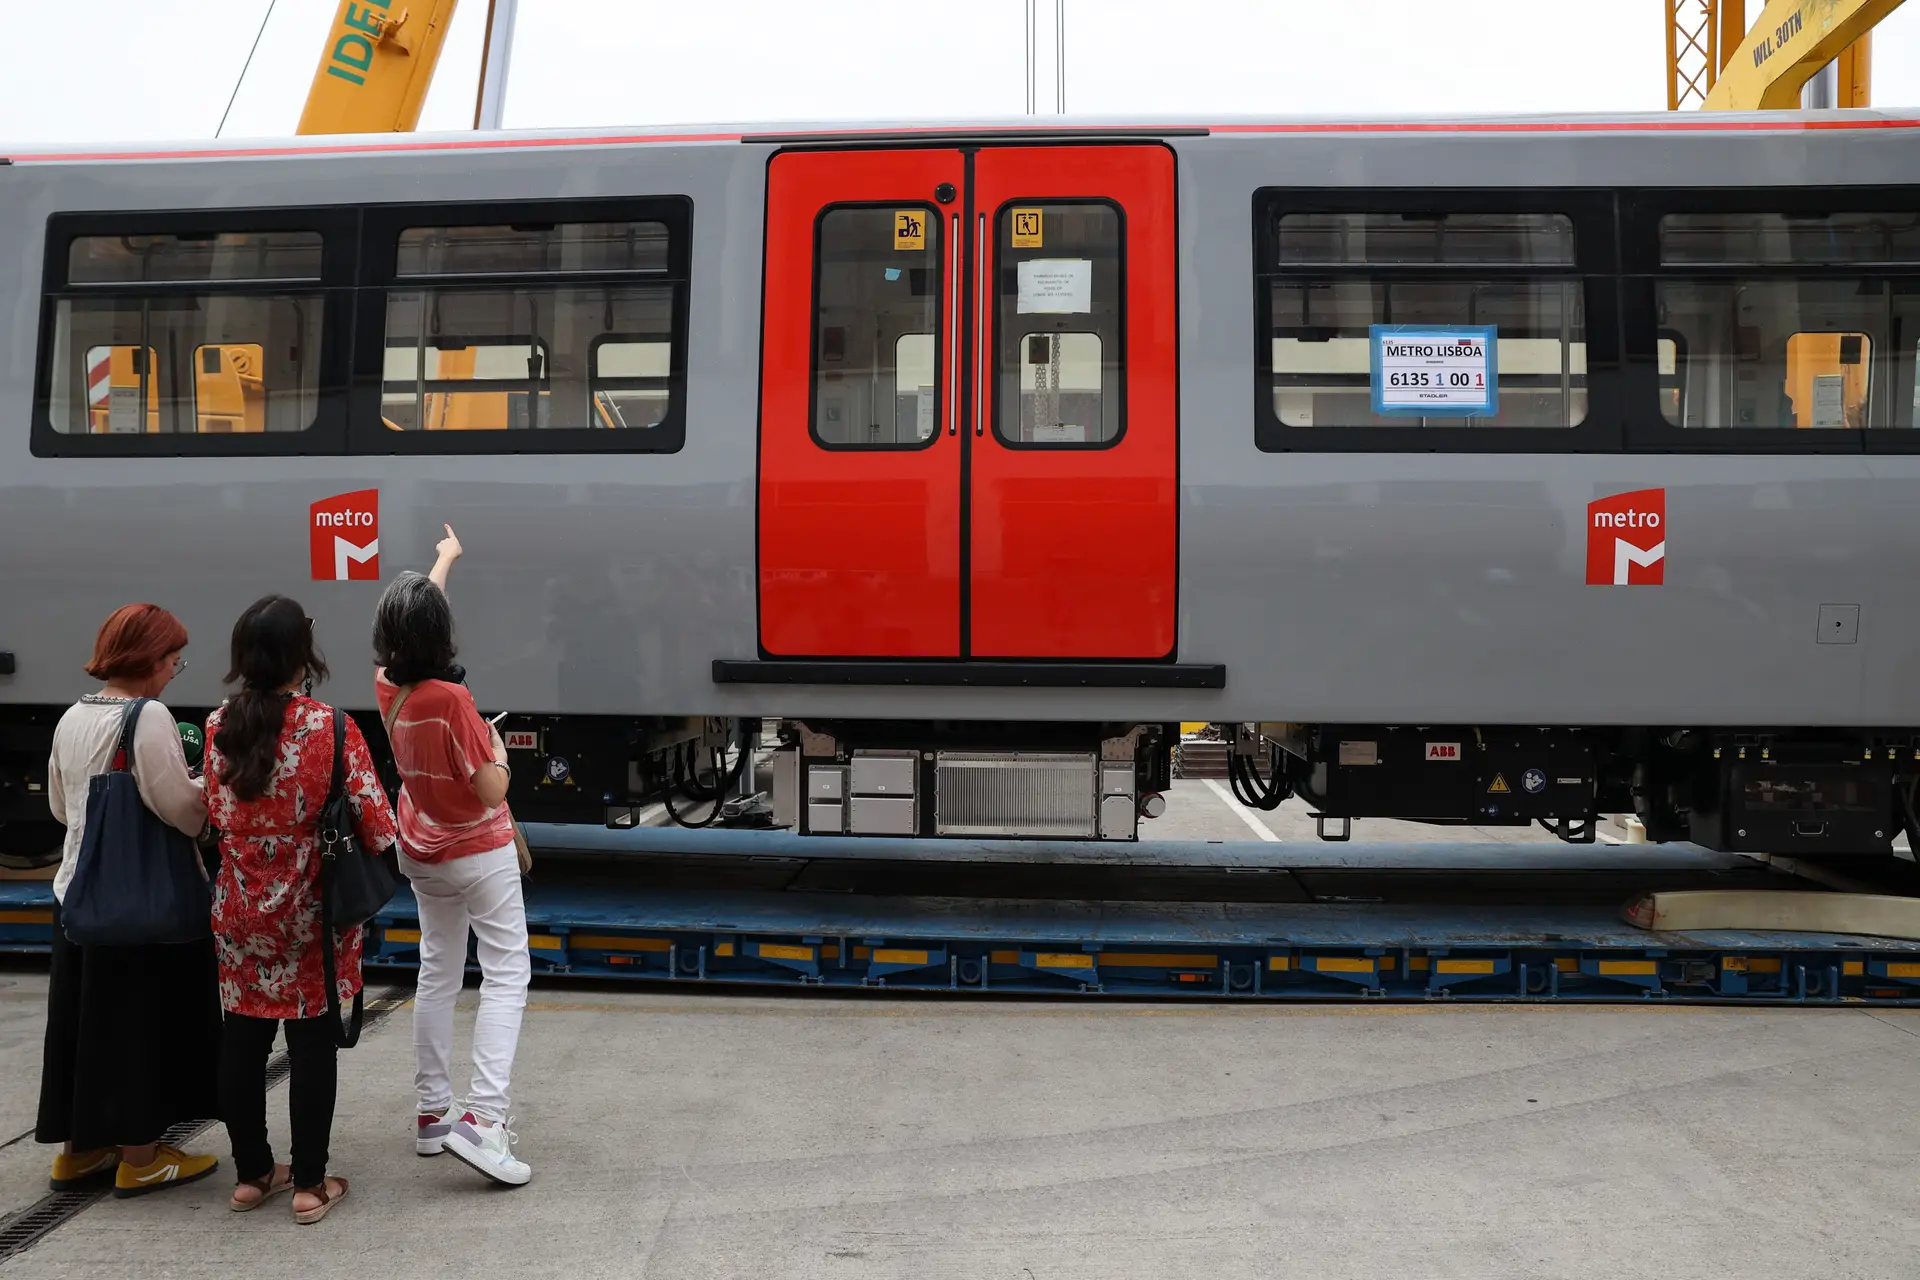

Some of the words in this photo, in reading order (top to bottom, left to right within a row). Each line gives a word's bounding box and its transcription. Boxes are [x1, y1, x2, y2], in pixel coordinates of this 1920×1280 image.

[1753, 36, 1775, 68] WLL.
[1775, 8, 1802, 49] 30TN
[1387, 346, 1433, 357] METRO
[1437, 346, 1483, 357] LISBOA
[1390, 373, 1429, 386] 6135
[1435, 373, 1444, 386] 1
[1450, 373, 1470, 386] 00
[1475, 373, 1484, 386] 1
[316, 508, 374, 527] metro
[1594, 508, 1660, 528] metro
[181, 734, 200, 746] USA
[509, 734, 533, 746] ABB
[1430, 746, 1456, 757] ABB
